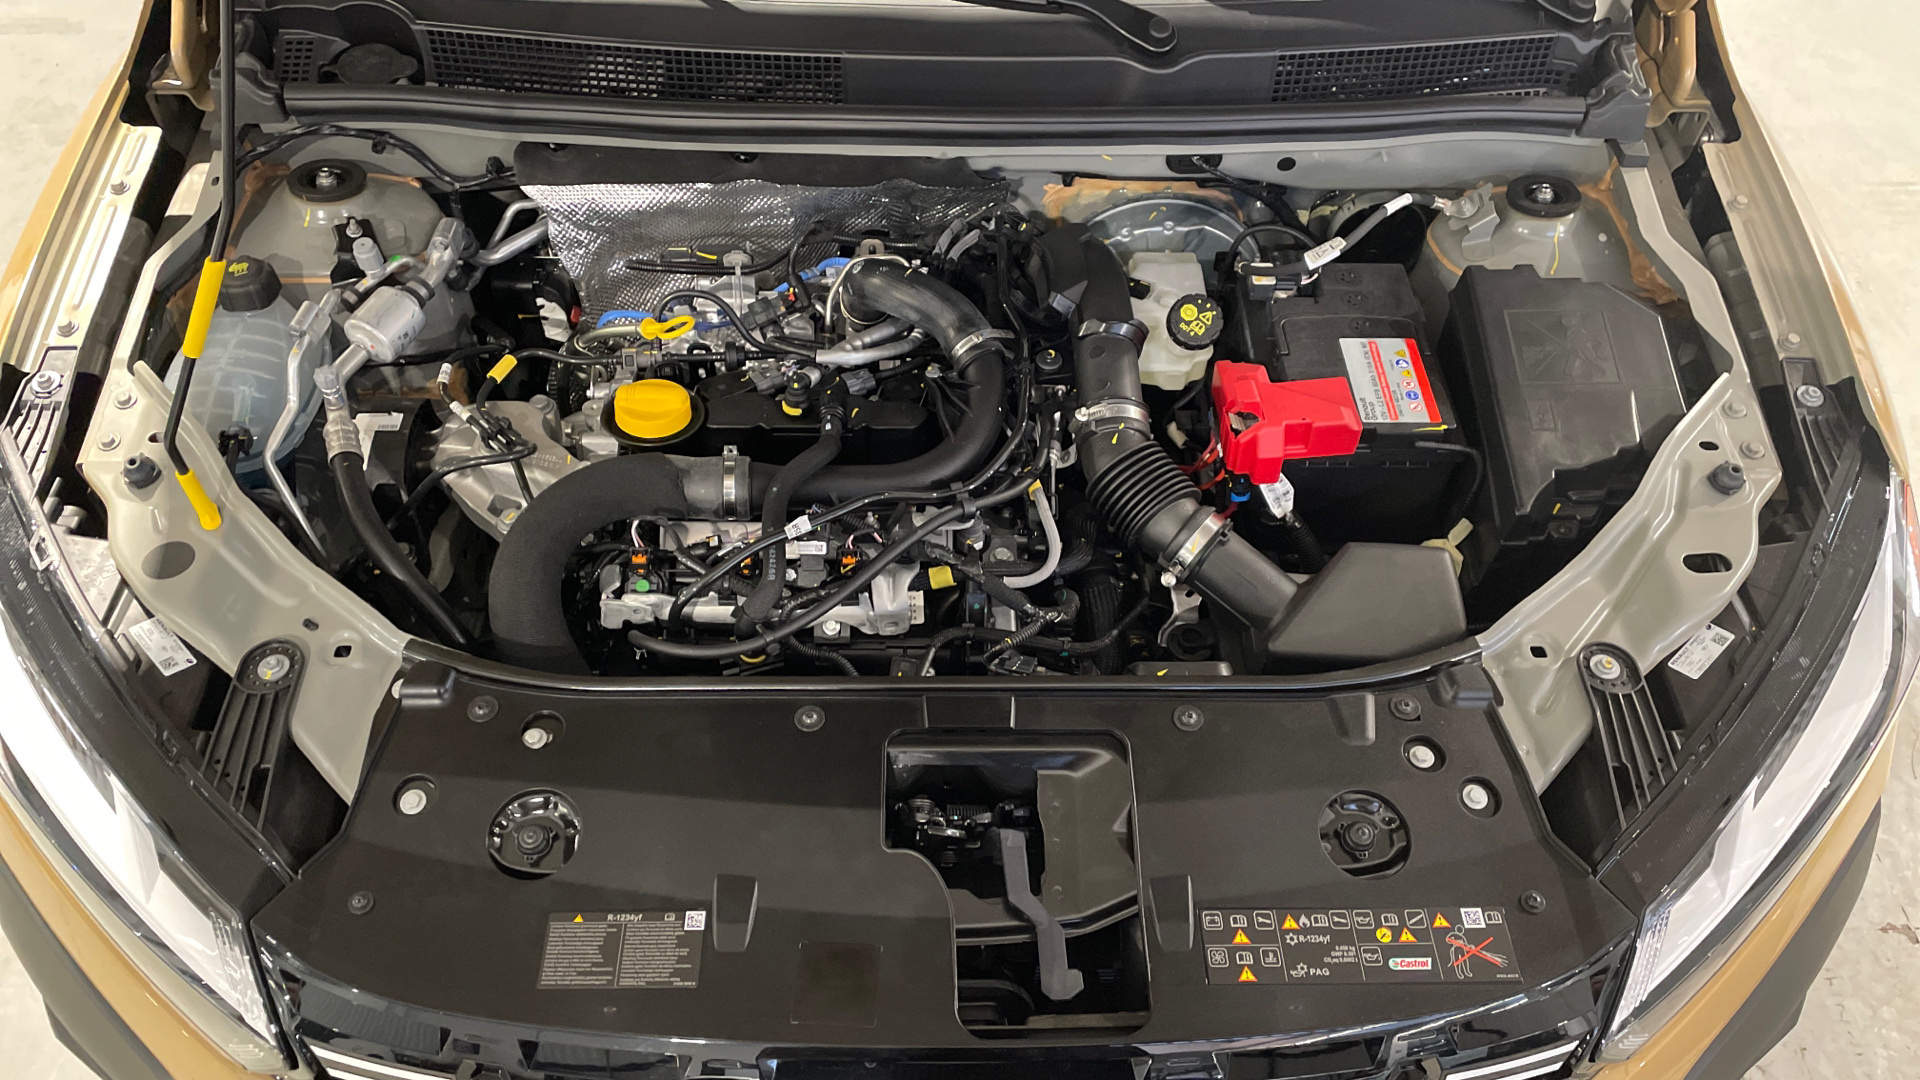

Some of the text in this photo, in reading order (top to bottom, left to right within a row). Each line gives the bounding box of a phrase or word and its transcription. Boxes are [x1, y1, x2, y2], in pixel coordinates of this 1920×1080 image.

[1180, 322, 1190, 332] DOT
[1359, 397, 1372, 421] Renault
[1368, 401, 1378, 421] Group
[1670, 647, 1688, 665] RENAULT
[607, 913, 643, 923] R-1234yf
[1299, 934, 1330, 944] R-1234yf
[1400, 959, 1429, 968] Castrol
[1309, 967, 1330, 976] PAG
